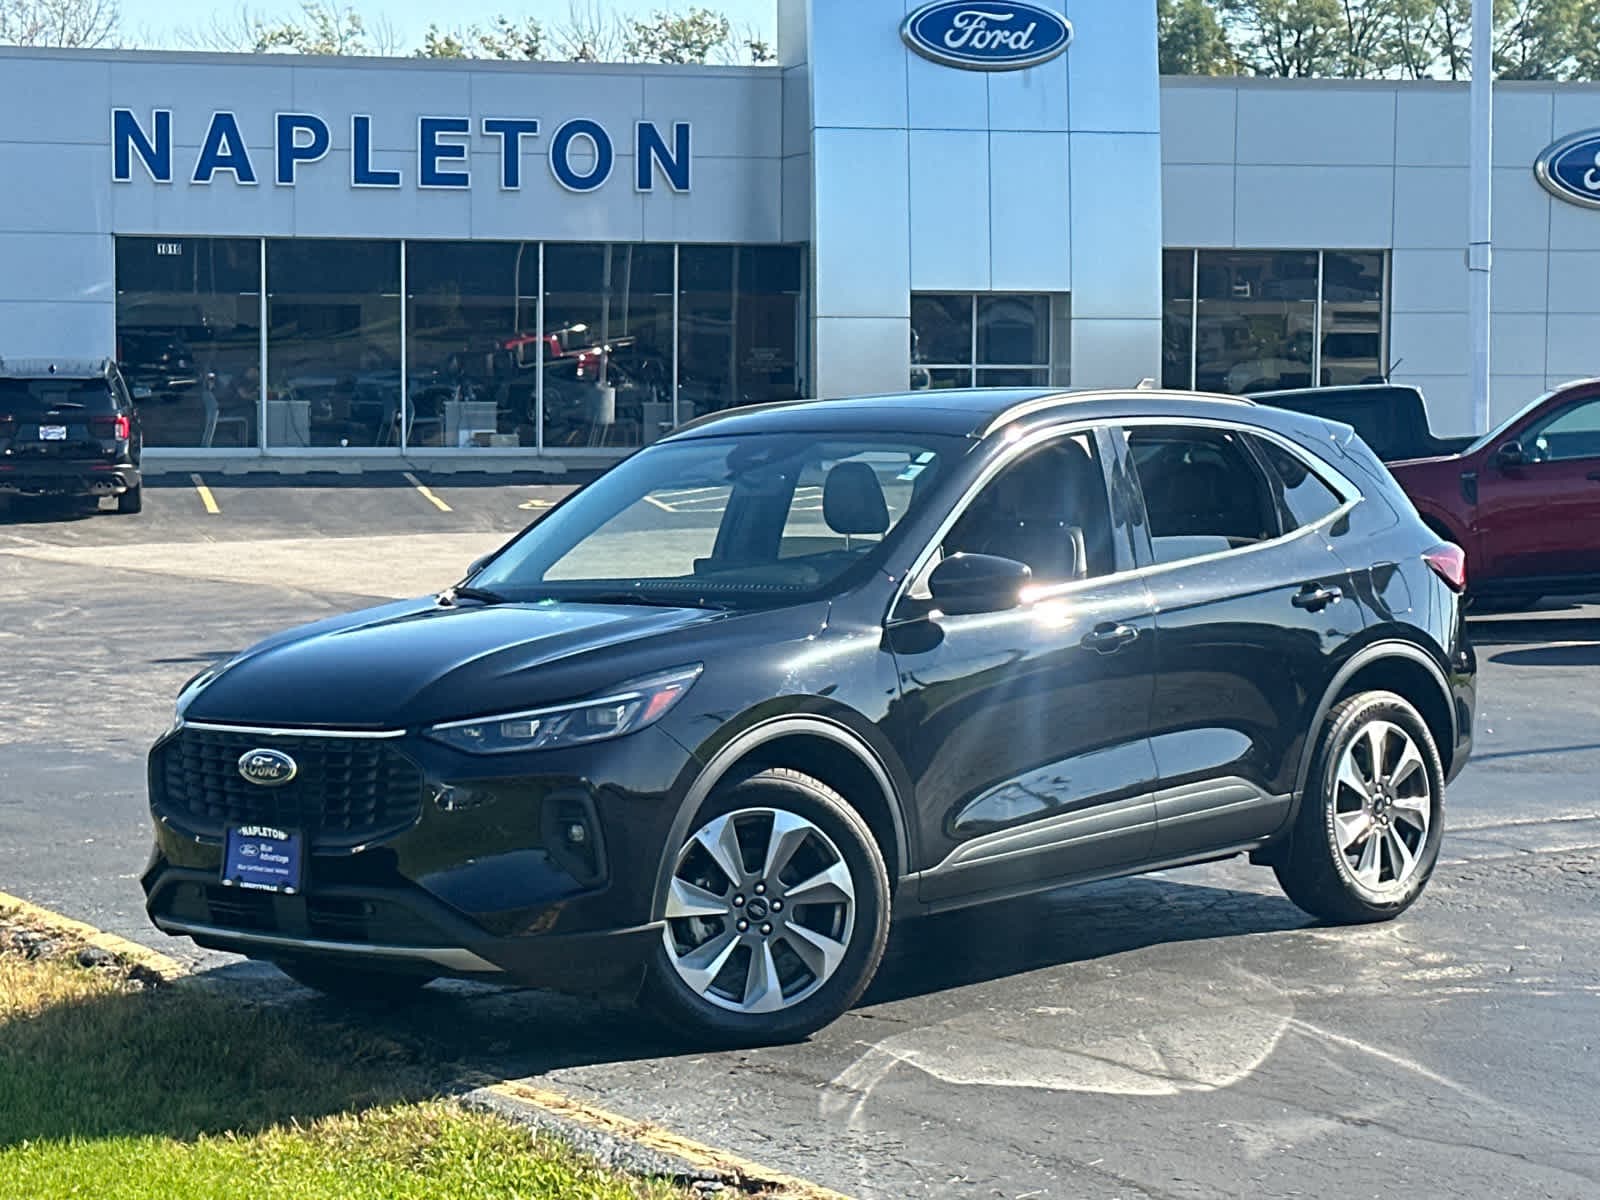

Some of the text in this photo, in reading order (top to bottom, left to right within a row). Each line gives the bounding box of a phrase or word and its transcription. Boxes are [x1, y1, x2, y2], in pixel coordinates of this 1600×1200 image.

[944, 10, 1037, 50] Ford
[110, 107, 692, 193] NAPLETON
[248, 755, 281, 777] Ford
[240, 826, 287, 840] NAPLETON
